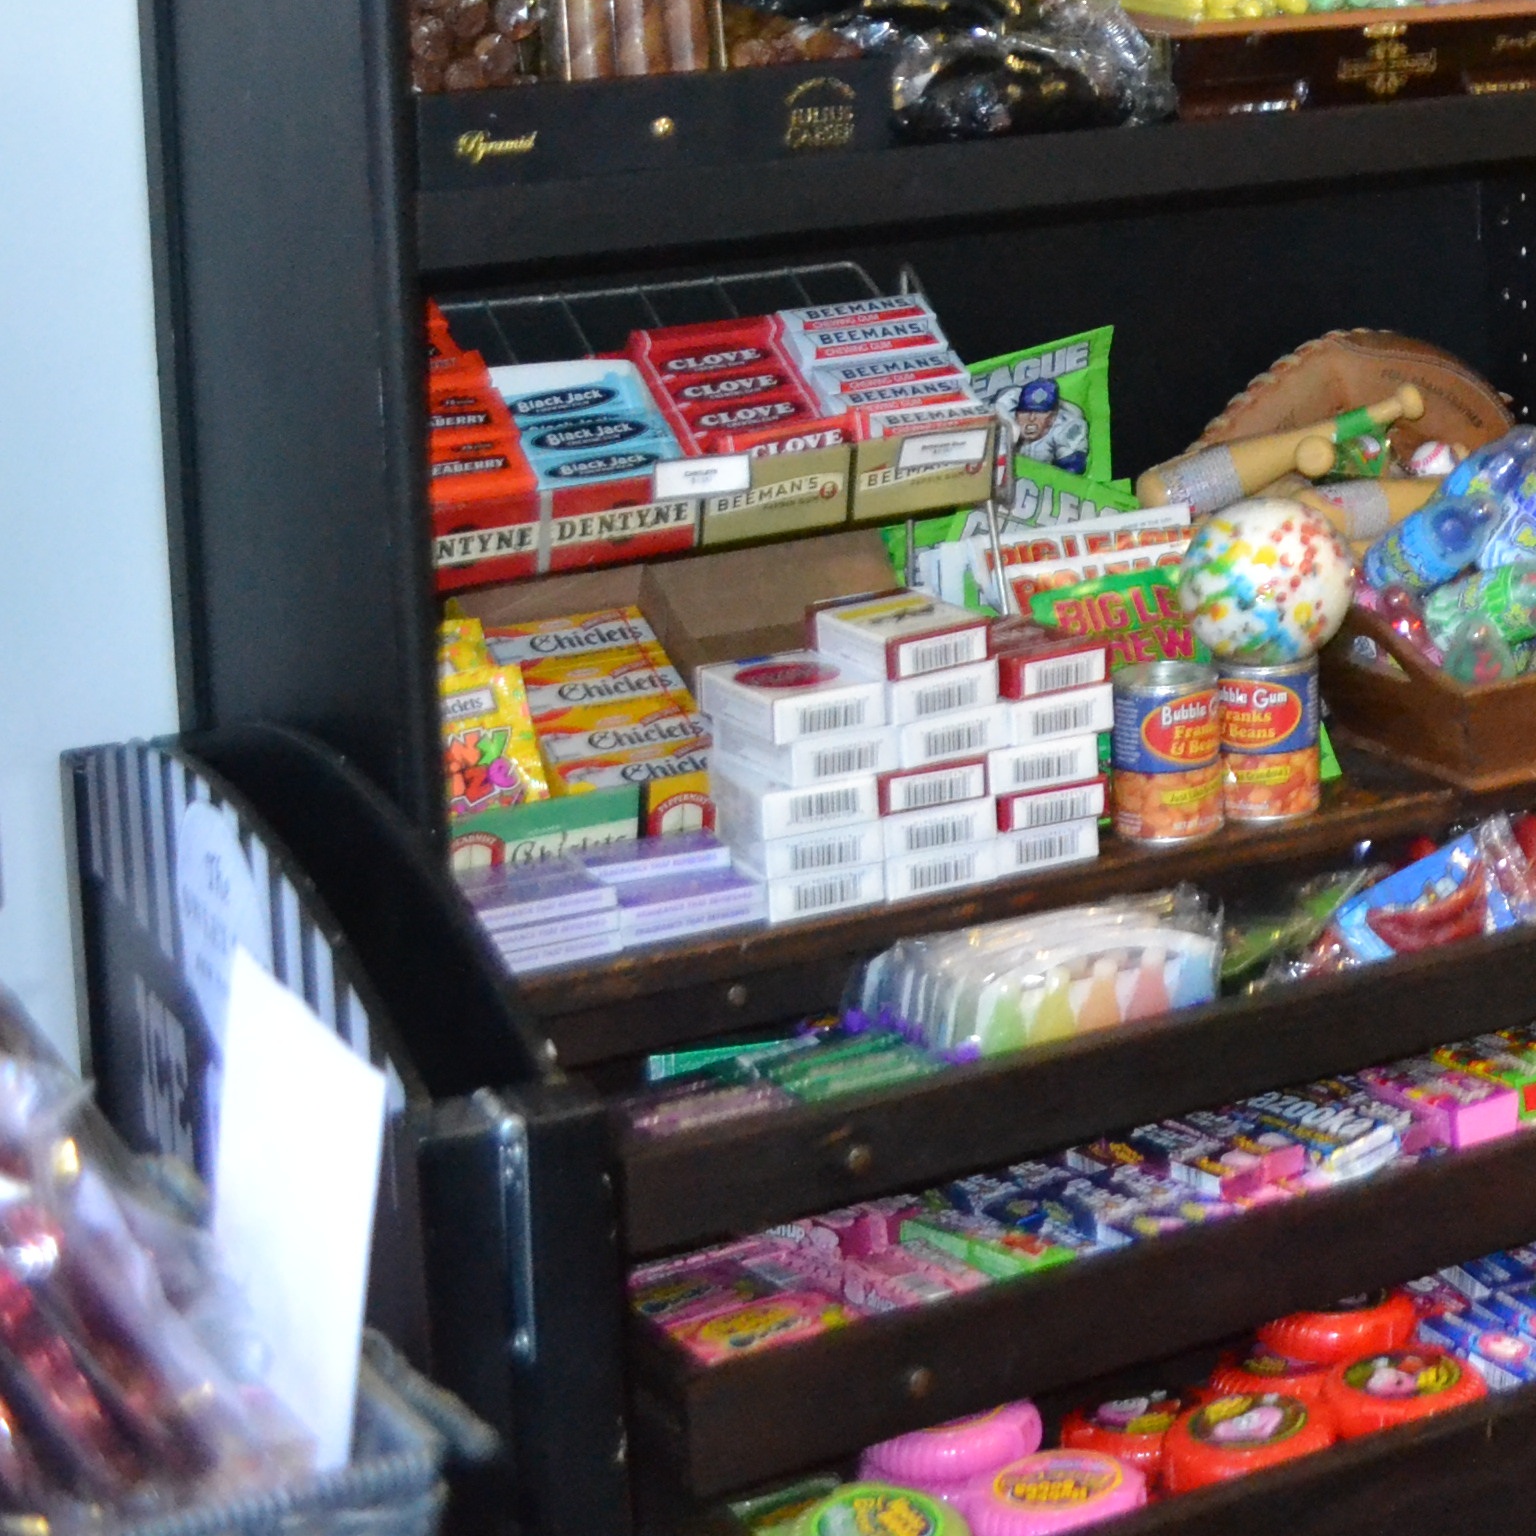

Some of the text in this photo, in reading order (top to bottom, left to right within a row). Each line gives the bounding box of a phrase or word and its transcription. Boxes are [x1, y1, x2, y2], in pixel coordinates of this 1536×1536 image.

[805, 296, 911, 320] BEEMANS
[818, 321, 923, 346] BEEMANS
[667, 346, 761, 372] CLOVE
[841, 354, 947, 380] BEEMANS
[682, 373, 778, 399] CLOVE
[848, 379, 952, 405] BEEMANS
[517, 387, 604, 415] Black Jack
[699, 401, 795, 427] CLOVE
[885, 404, 996, 427] BEEMANS
[545, 419, 635, 448] Black Jack
[559, 449, 648, 477] Black Jack
[716, 476, 820, 513] BEEMAN'S
[557, 500, 690, 542] DENTYNE
[437, 525, 532, 560] NTYNE
[1054, 590, 1128, 636] BIG
[529, 623, 645, 654] Chiclets
[557, 670, 676, 703] Chiclets
[1252, 687, 1288, 709] Gum
[1160, 701, 1208, 727] Bubble
[587, 716, 706, 751] Chiclets
[1229, 723, 1276, 739] Beans
